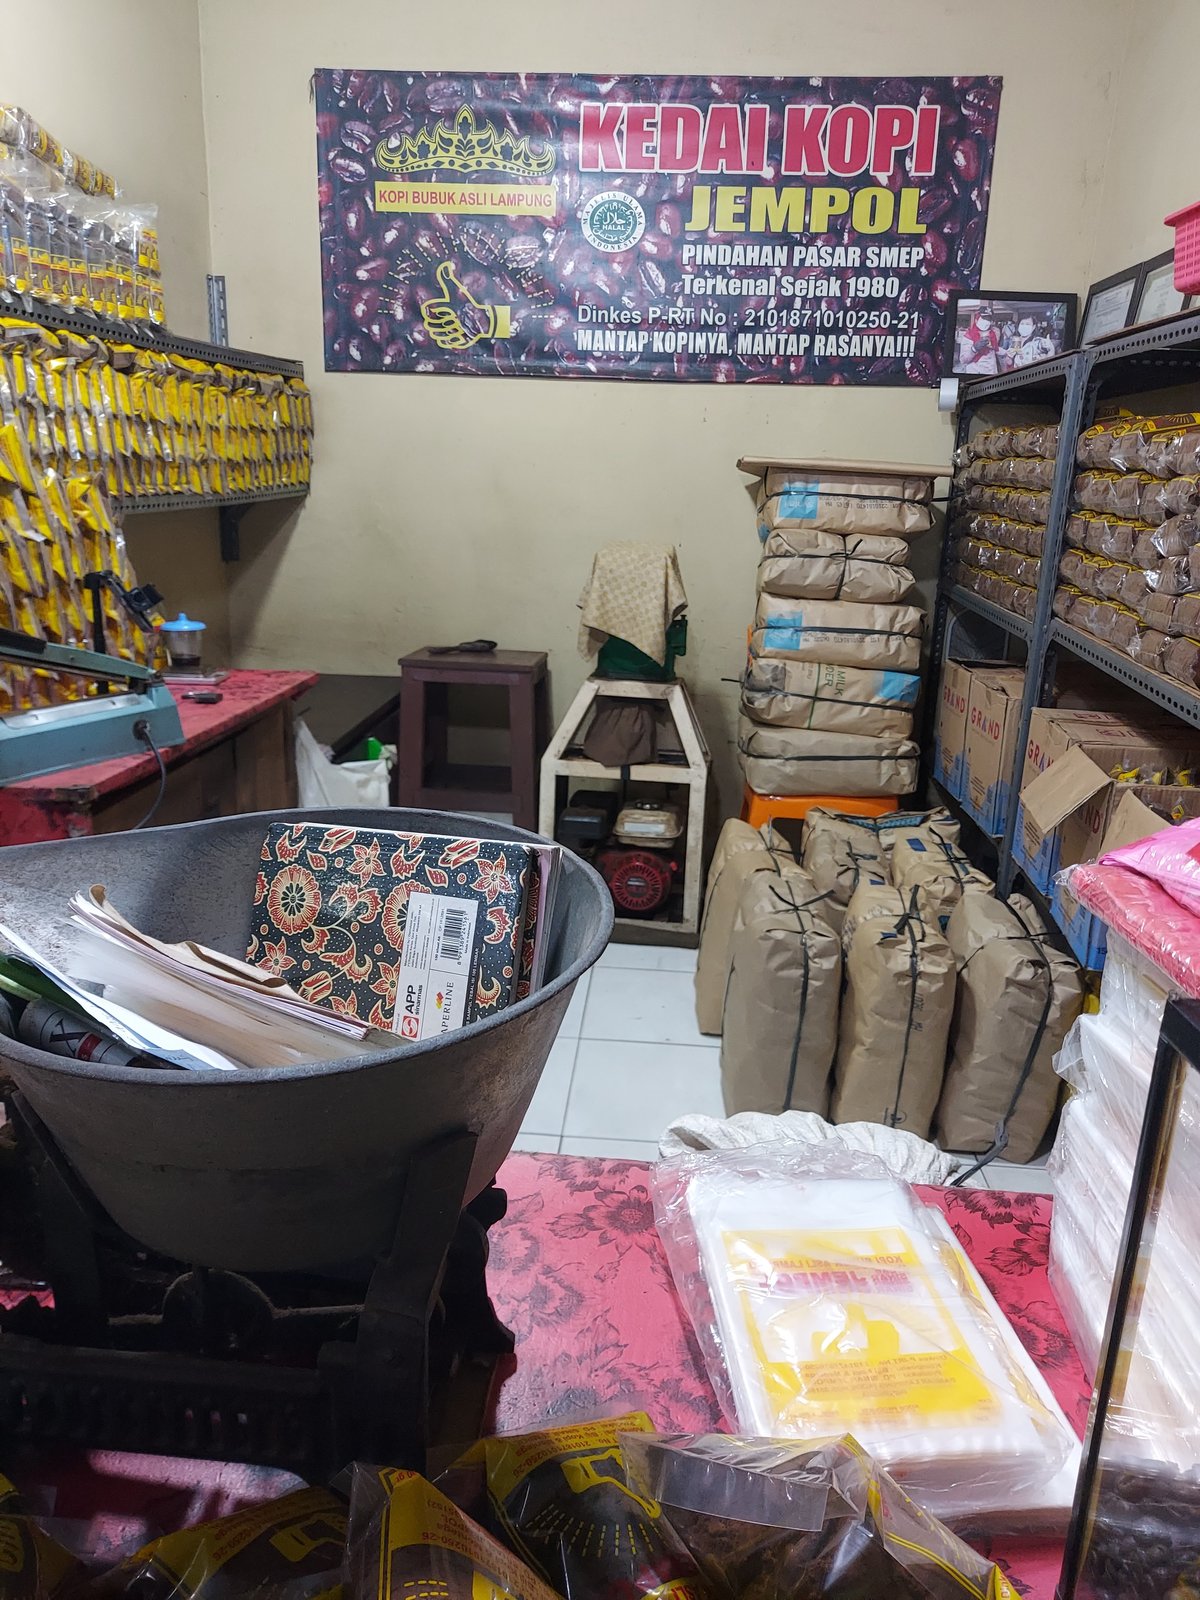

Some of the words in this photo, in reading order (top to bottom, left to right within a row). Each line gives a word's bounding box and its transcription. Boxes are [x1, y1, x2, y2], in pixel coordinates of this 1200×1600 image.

[578, 102, 769, 174] KEDAI
[781, 103, 940, 176] KOPI
[379, 190, 408, 204] KOPI
[412, 191, 456, 205] BUBUK
[459, 192, 487, 206] ASLI
[491, 193, 552, 207] LAMPUNG
[583, 193, 617, 225] MAJELIS
[623, 195, 643, 226] ULAMA
[685, 186, 927, 234] JEMPOL
[587, 233, 637, 250] INDONESIA
[682, 244, 788, 267] PINDAHAN
[793, 246, 861, 268] PASAR
[866, 246, 924, 268] SMEP
[682, 274, 776, 296] Terkenal
[781, 276, 841, 299] Sejak
[847, 277, 899, 298] 1980
[578, 305, 641, 323] Dinkes
[700, 308, 726, 326] No
[744, 309, 919, 328] 2101871010250-21
[577, 330, 649, 352] MANTAP
[652, 331, 733, 356] KOPINYA,
[737, 333, 811, 356] MANTAP
[814, 335, 917, 358] RASANYA!!!
[834, 670, 846, 697] MILK
[943, 686, 966, 713] GRAND
[971, 706, 1000, 741] GRAND
[405, 984, 416, 1014] APP
[415, 984, 423, 1015] sinarmas
